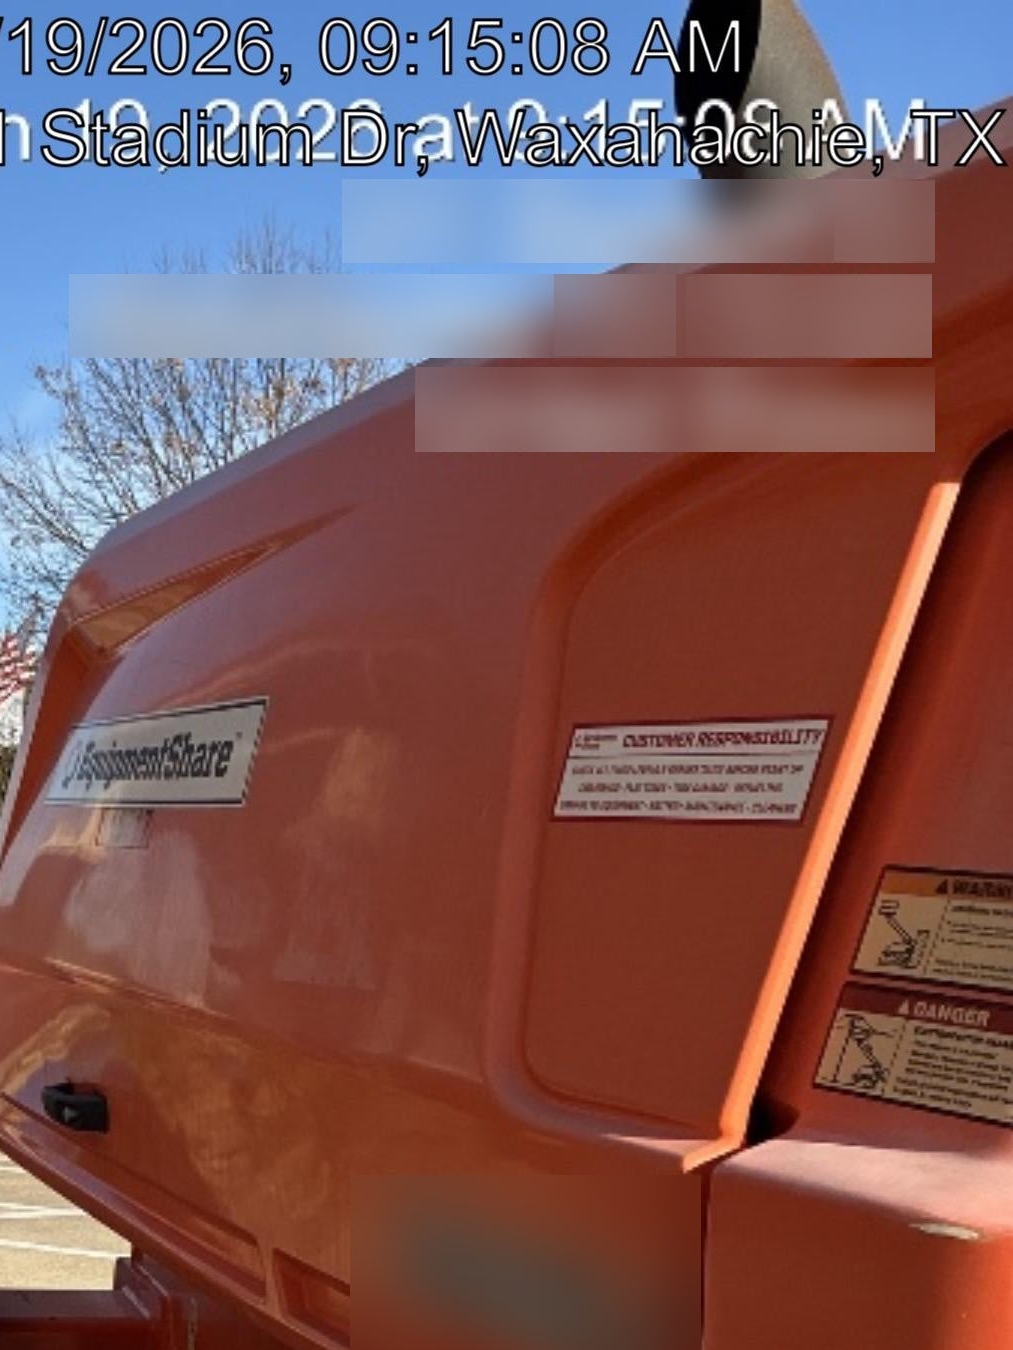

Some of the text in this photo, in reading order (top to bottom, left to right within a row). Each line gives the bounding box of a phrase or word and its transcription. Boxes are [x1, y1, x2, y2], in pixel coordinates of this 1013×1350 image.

[623, 732, 694, 748] CUSTOMER
[696, 728, 824, 748] RESPONSIBILITY
[76, 732, 235, 790] EquipmentShare
[913, 1001, 990, 1027] DANGER
